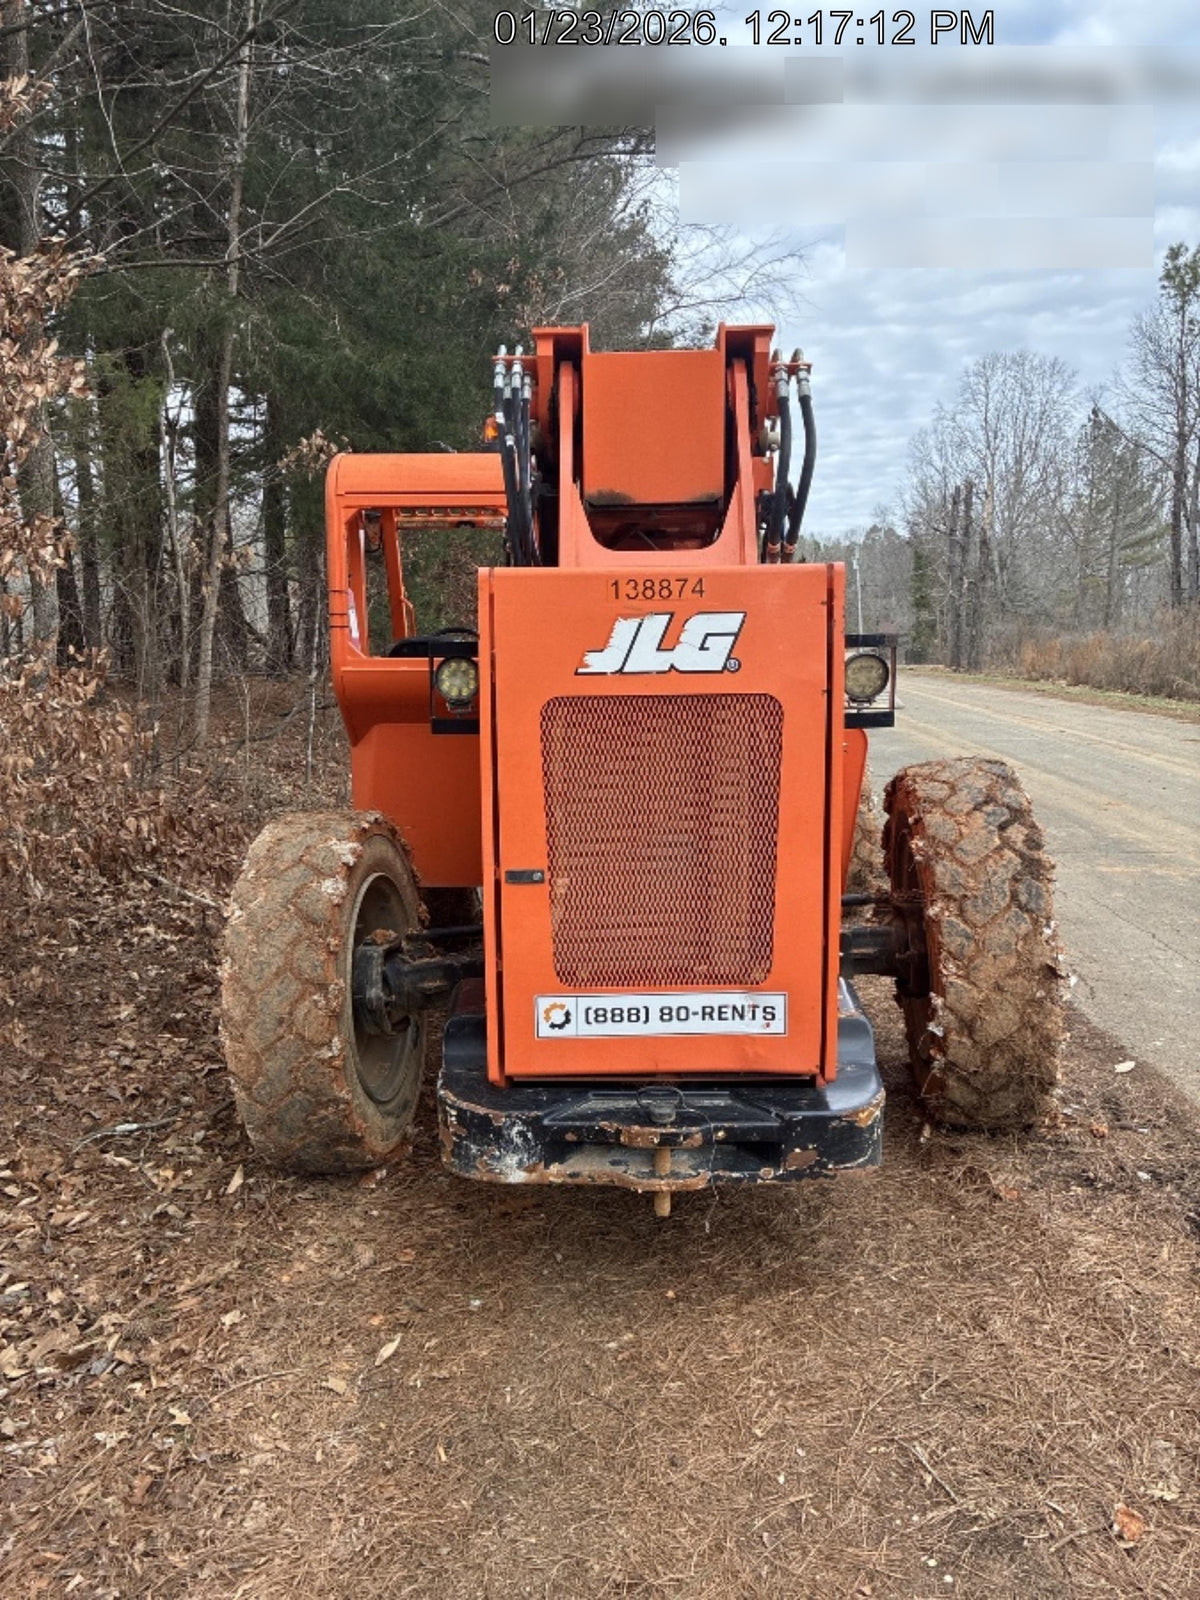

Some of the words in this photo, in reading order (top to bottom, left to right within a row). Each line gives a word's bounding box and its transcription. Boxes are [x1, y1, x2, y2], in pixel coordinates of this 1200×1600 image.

[610, 577, 705, 600] 138874
[574, 611, 747, 676] JLG
[584, 1006, 650, 1024] (888)
[659, 1004, 776, 1023] 80-RENTS
